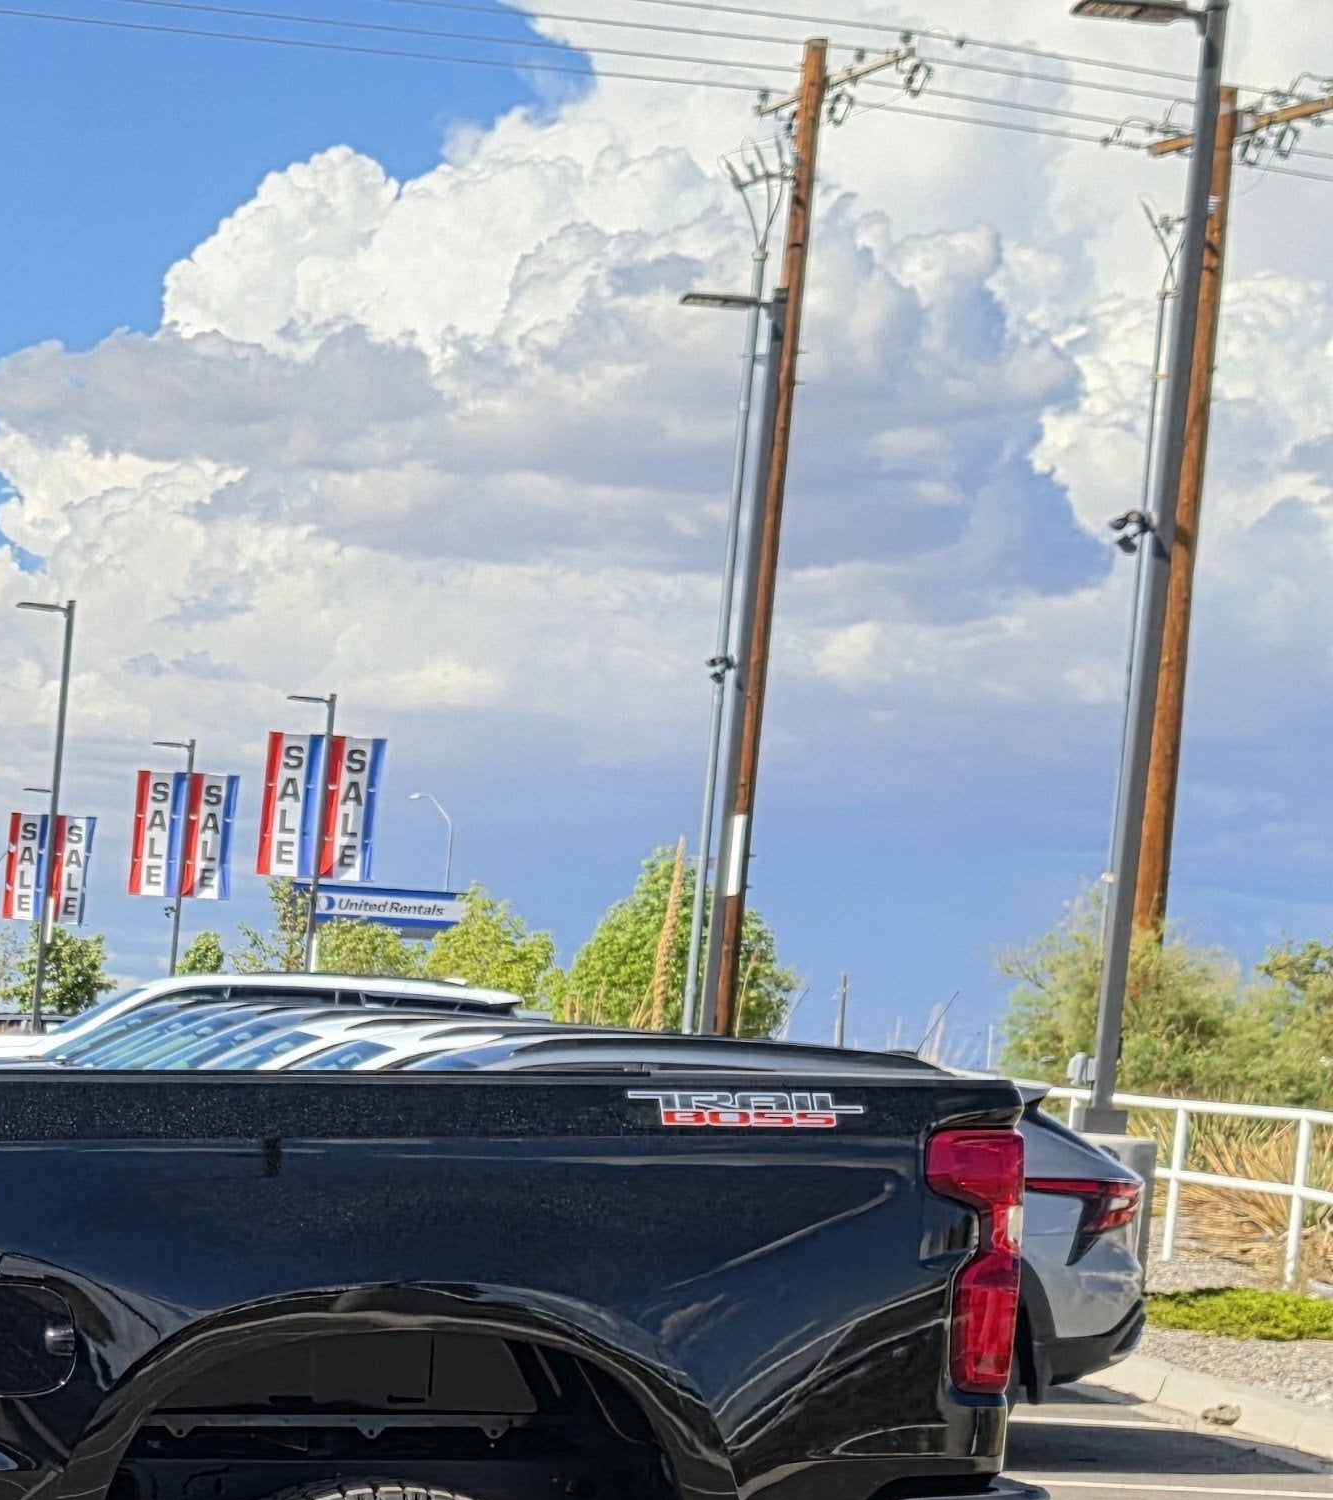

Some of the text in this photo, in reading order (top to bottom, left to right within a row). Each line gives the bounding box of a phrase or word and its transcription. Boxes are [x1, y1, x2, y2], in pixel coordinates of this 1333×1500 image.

[145, 782, 170, 886] SALE
[199, 785, 222, 888] SALE
[276, 746, 304, 865] SALE
[338, 749, 366, 867] SALE
[17, 823, 37, 912] SALE
[63, 826, 83, 916] SALE
[337, 898, 445, 917] United Rentals
[627, 1091, 864, 1114] TRAIL
[660, 1110, 837, 1128] BOSS
